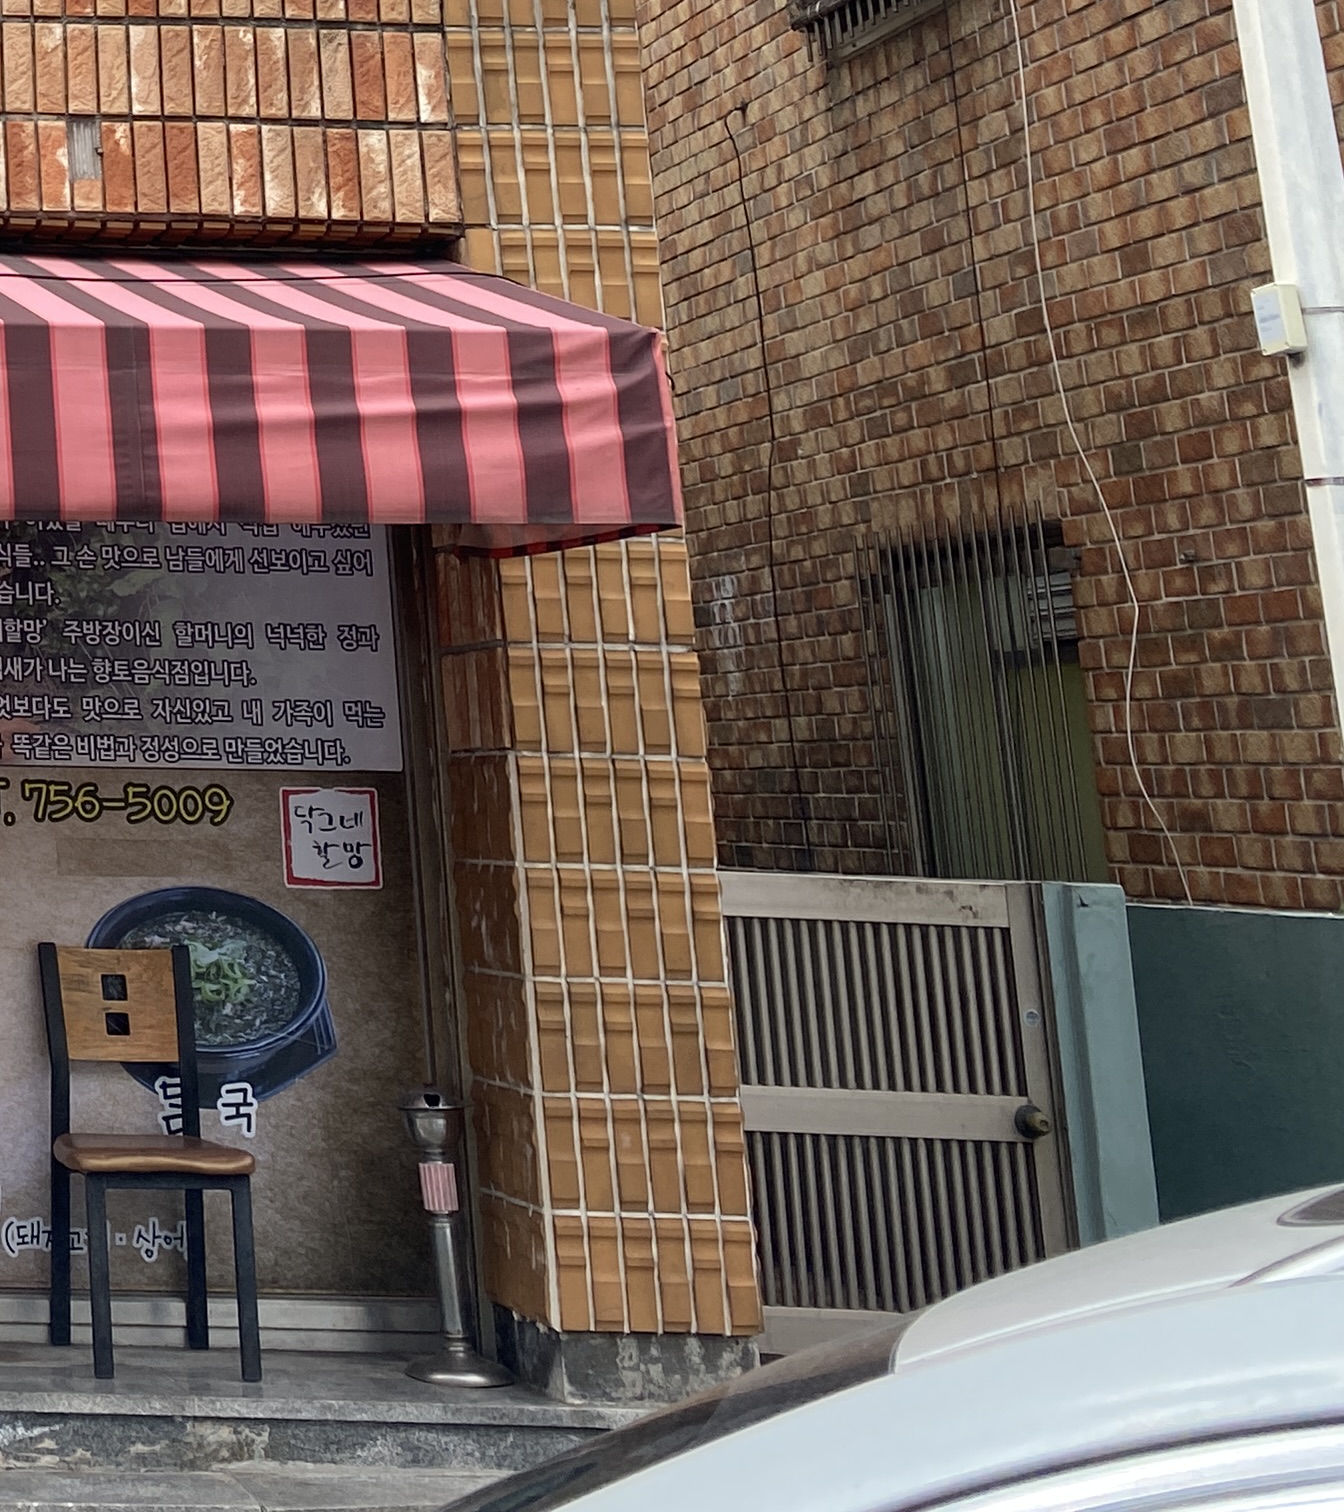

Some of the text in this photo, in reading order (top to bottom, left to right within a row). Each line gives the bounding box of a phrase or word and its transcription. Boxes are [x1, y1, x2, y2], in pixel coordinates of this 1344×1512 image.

[165, 546, 245, 573] 남들에게
[249, 548, 329, 575] 선보이고
[332, 549, 374, 576] 싶어
[62, 619, 161, 646] 주방장이신
[173, 621, 254, 649] 할머니의
[265, 623, 327, 650] 넉넉한
[337, 625, 380, 652] 정과
[47, 656, 88, 683] 나는
[90, 658, 258, 687] 향토음식점입니다.
[81, 695, 143, 722] 맛으로
[151, 697, 234, 724] 자신있고
[241, 698, 264, 726] 내
[272, 699, 334, 728] 가족이
[342, 700, 386, 728] 먹는
[11, 733, 74, 760] 똑같은
[75, 734, 137, 762] 비법과
[140, 735, 222, 763] 정성으로
[223, 737, 352, 766] 만들었습니다.
[293, 805, 364, 835] 닥그네
[311, 839, 373, 870] 할망
